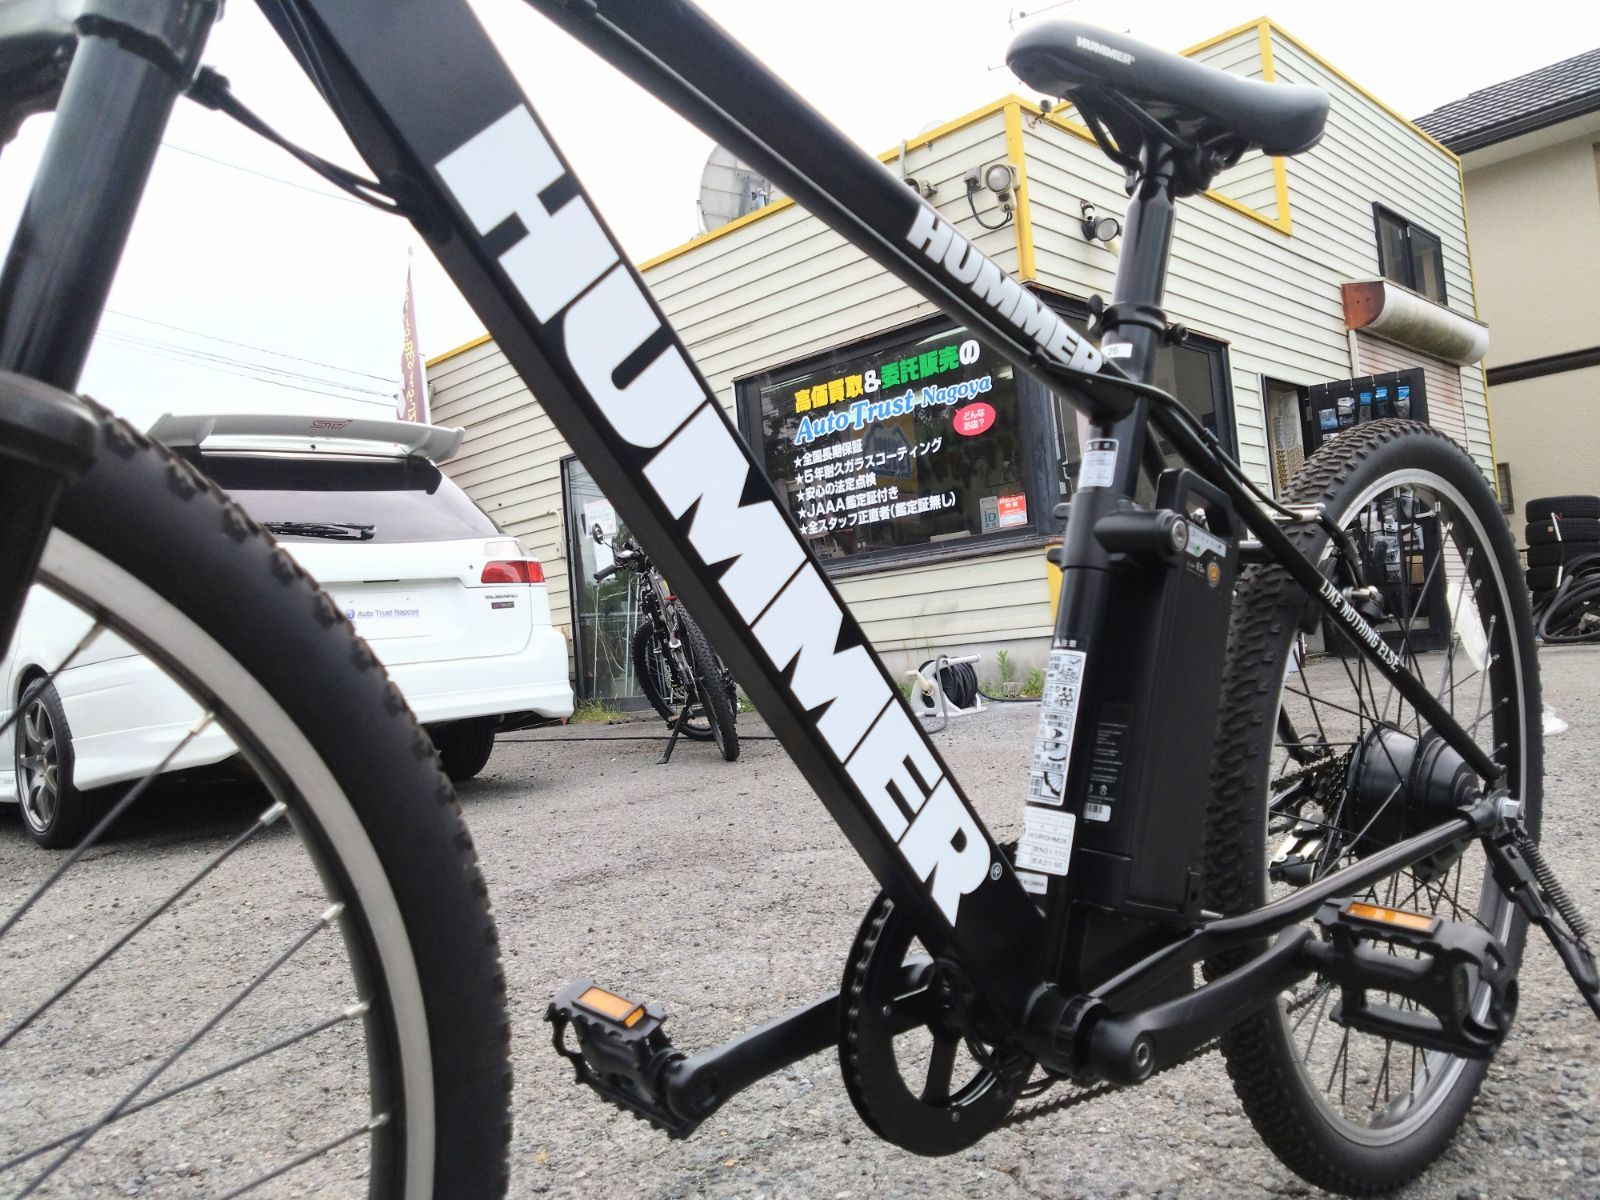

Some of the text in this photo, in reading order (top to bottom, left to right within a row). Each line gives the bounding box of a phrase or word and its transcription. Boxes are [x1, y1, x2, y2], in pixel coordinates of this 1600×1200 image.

[1077, 36, 1131, 65] HUMMER
[906, 205, 1103, 373] HUMMER
[794, 376, 992, 445] Auto Trust Nagoya
[963, 408, 985, 421] どんな
[435, 104, 992, 927] HUMMER
[375, 609, 393, 617] Trust
[1320, 580, 1342, 608] LIKE
[1339, 601, 1380, 649] NOTHING
